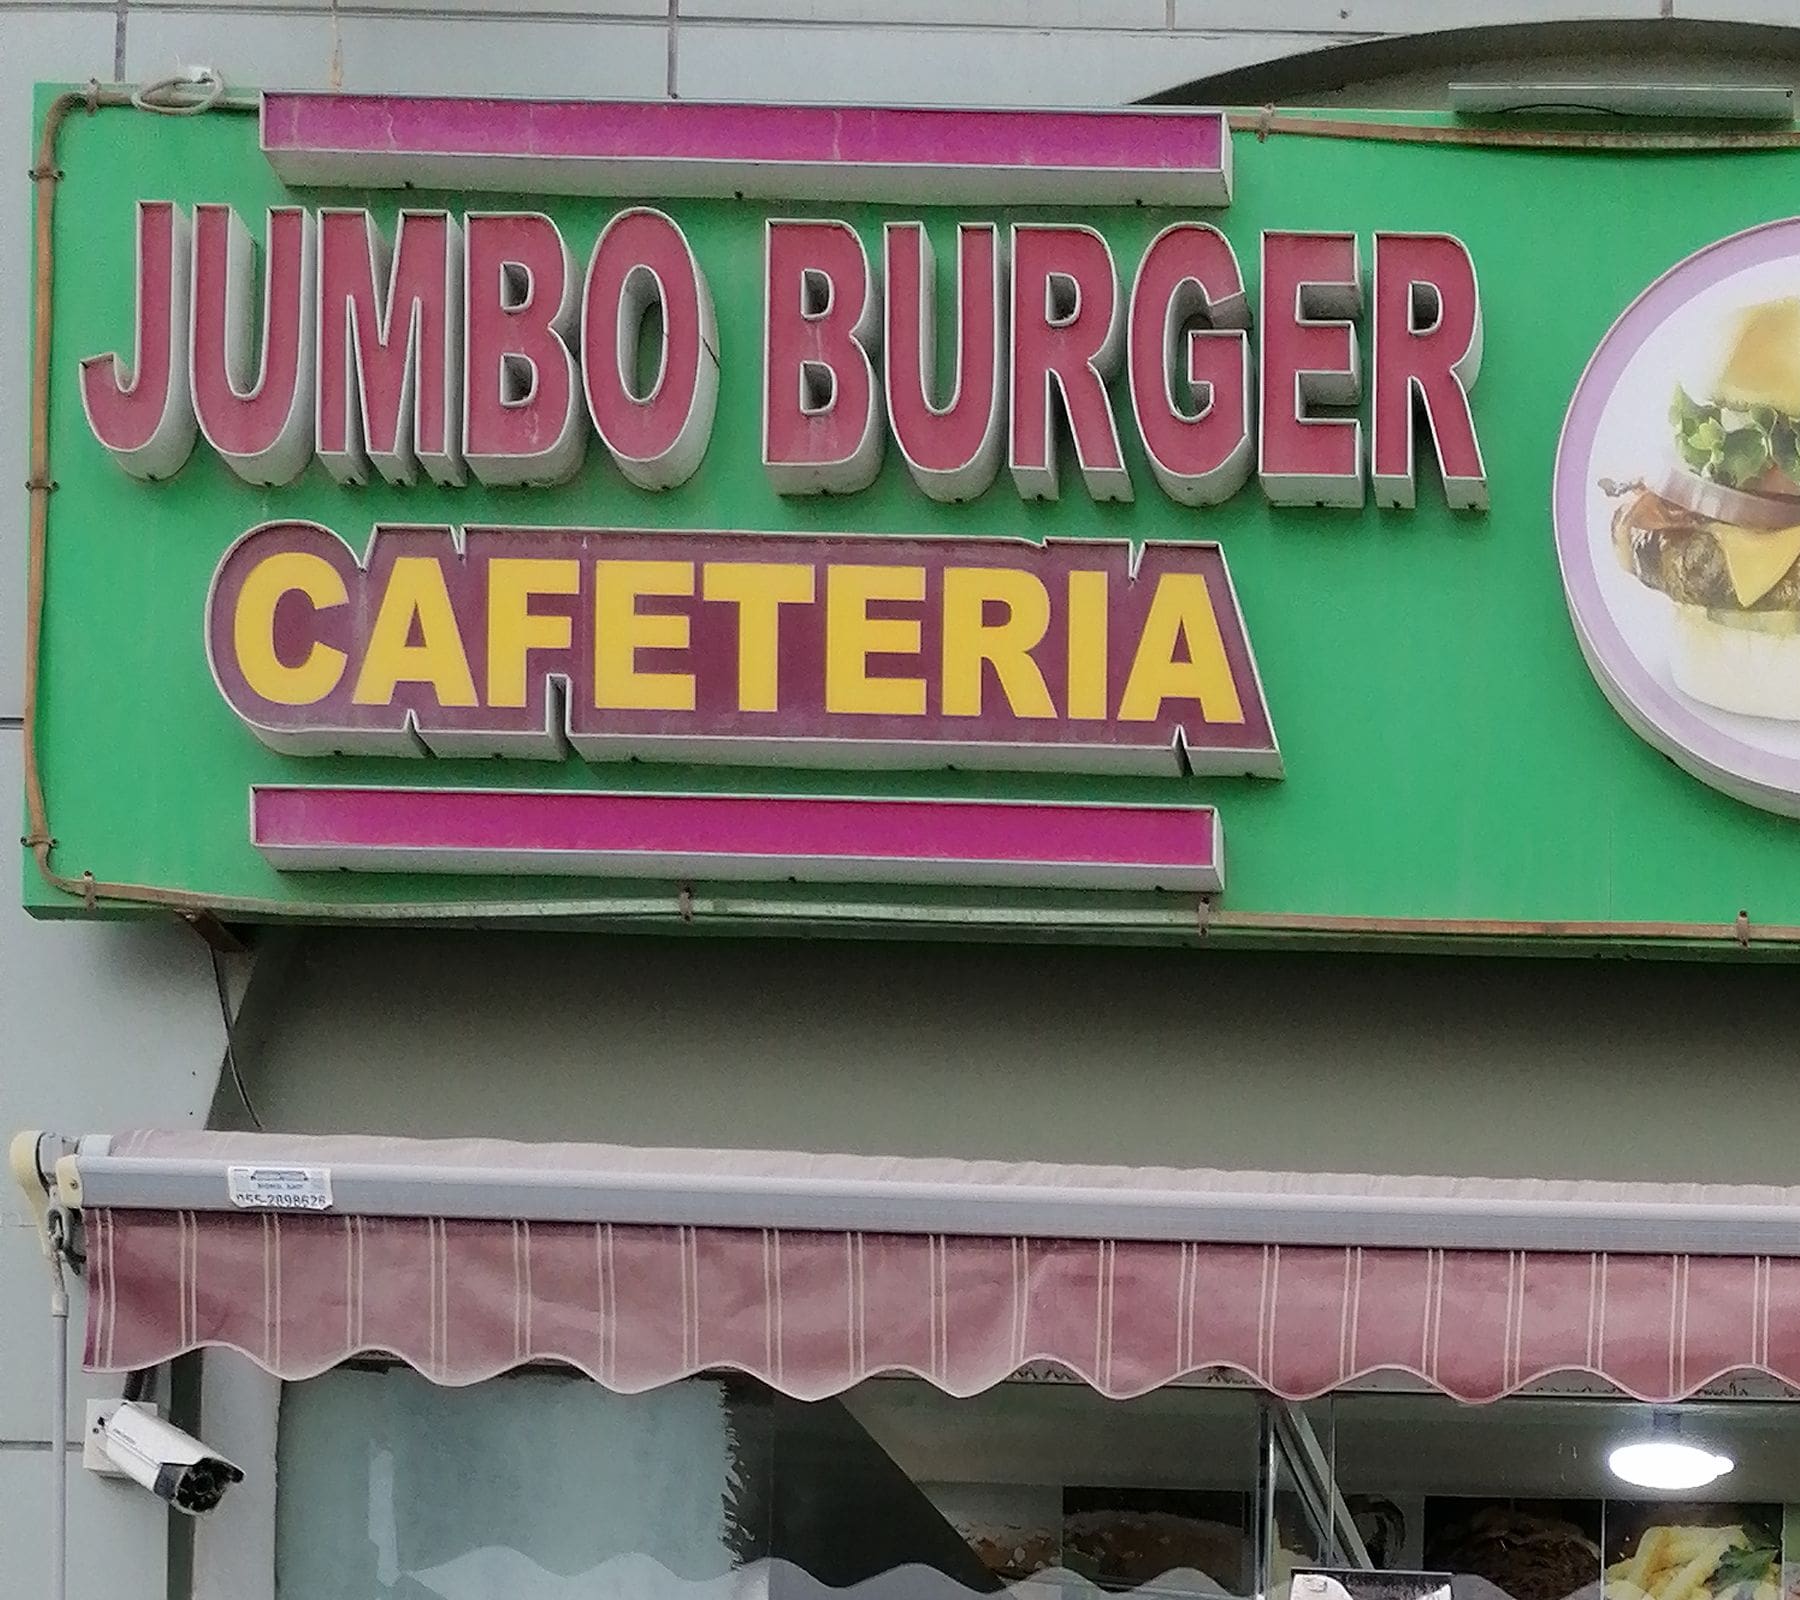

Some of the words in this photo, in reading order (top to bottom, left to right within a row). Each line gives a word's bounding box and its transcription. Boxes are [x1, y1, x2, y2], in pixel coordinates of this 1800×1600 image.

[80, 202, 718, 488] JUMBO
[762, 217, 1490, 510] BURGER
[232, 551, 1248, 725] CAFETERIA
